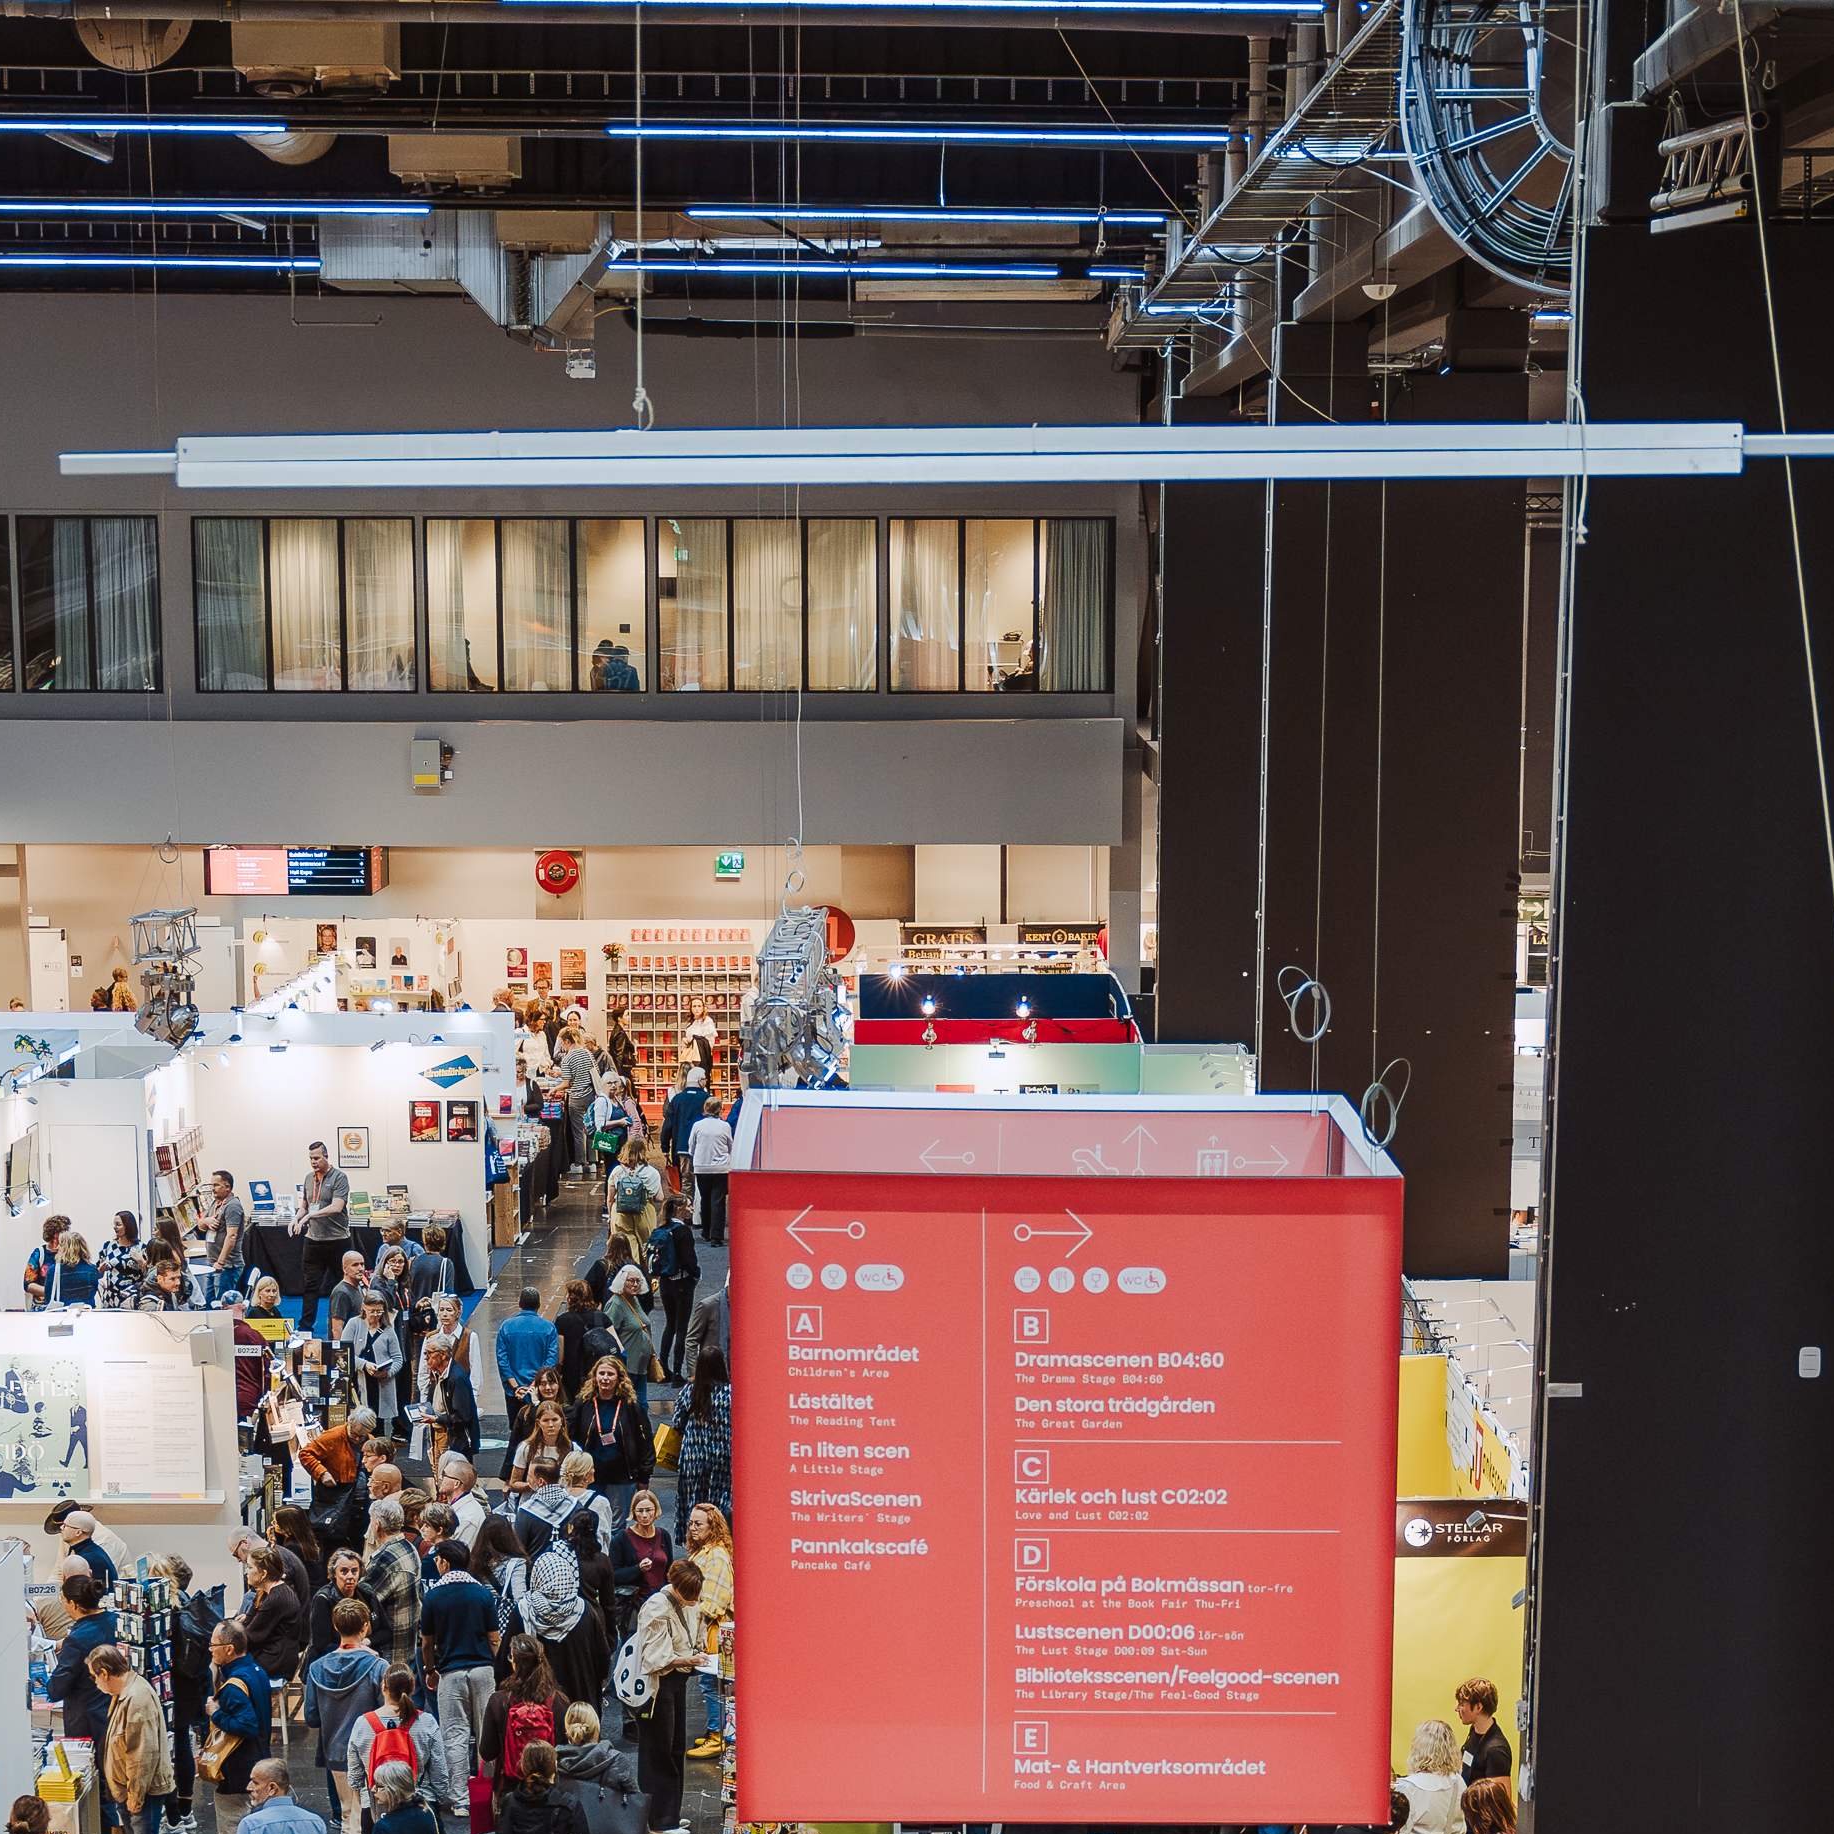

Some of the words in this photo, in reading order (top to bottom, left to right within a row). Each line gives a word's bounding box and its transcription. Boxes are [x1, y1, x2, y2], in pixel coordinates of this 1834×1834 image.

[861, 1272, 881, 1284] WC
[1124, 1275, 1144, 1286] WC
[795, 1314, 814, 1334] A
[1023, 1317, 1040, 1336] B
[788, 1345, 920, 1362] Barnområdet
[1014, 1351, 1154, 1369] Dramascenen
[1157, 1351, 1225, 1369] B04:60
[788, 1366, 856, 1378] Children's
[862, 1367, 890, 1379] Area
[789, 1392, 874, 1411] Lästältet
[1014, 1396, 1053, 1413] Den
[1055, 1397, 1105, 1413] stora
[1107, 1395, 1216, 1418] trädgården
[789, 1441, 813, 1458] En
[817, 1440, 860, 1459] liten
[863, 1445, 910, 1459] scen
[1022, 1456, 1042, 1478] C
[790, 1489, 922, 1508] SkrivaScenen
[1015, 1487, 1077, 1505] Kärlek
[1080, 1488, 1117, 1505] och
[1121, 1488, 1158, 1505] lust
[1160, 1488, 1228, 1505] C02:02
[791, 1538, 929, 1556] Pannkakscafé
[1447, 1535, 1490, 1543] FÖRLAG
[1023, 1546, 1042, 1565] D
[790, 1559, 838, 1571] Pancake
[843, 1560, 872, 1571] Café
[28, 1586, 57, 1594] B07:26
[1015, 1575, 1097, 1593] Förskola
[1100, 1576, 1128, 1597] på
[1131, 1576, 1245, 1594] Bokmässan
[1247, 1583, 1293, 1594] tor-fre
[1015, 1623, 1124, 1640] Lustscenen
[1128, 1623, 1196, 1641] D00:06
[1198, 1630, 1244, 1641] lör-sön
[1015, 1666, 1340, 1688] Biblioteksscenen/Feelgood-scenen
[1024, 1729, 1037, 1748] E
[1014, 1758, 1062, 1774] Mat-
[1066, 1759, 1082, 1775] &
[1085, 1757, 1267, 1776] Hantverksområdet
[1013, 1779, 1041, 1790] Food
[1045, 1779, 1055, 1790] &
[1059, 1779, 1093, 1791] Craft
[1098, 1780, 1126, 1791] Area
